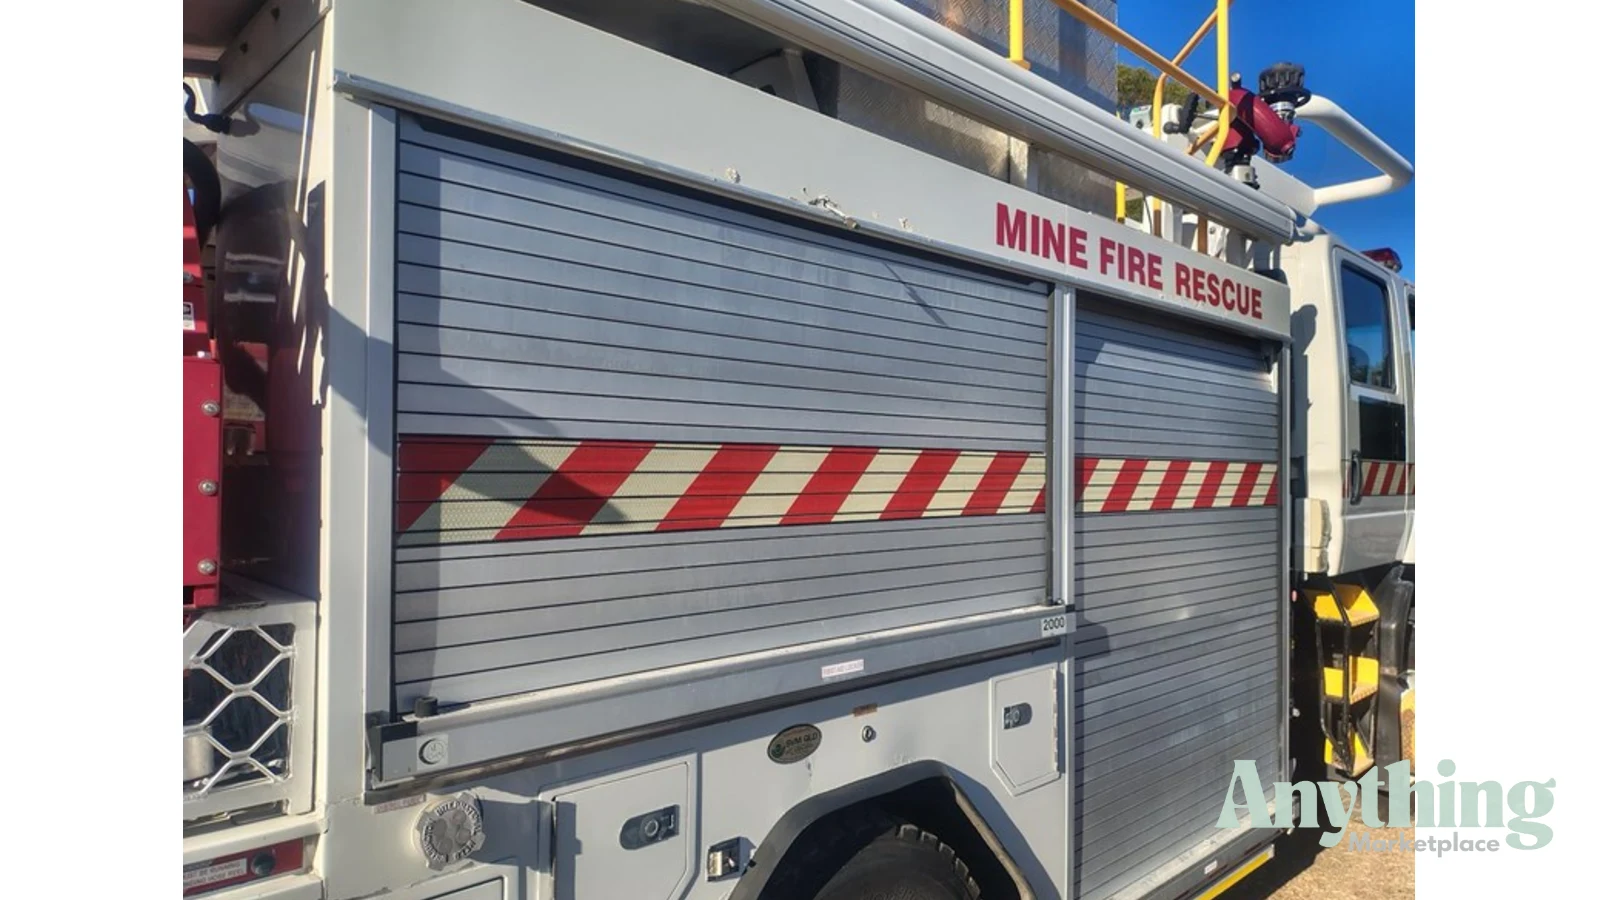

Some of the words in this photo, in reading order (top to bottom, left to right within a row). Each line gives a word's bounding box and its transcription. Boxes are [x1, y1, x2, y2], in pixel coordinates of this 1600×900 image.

[995, 202, 1088, 270] MINE
[1099, 237, 1163, 290] FIRE
[1174, 262, 1263, 320] RESCUE
[1043, 616, 1065, 631] 2000
